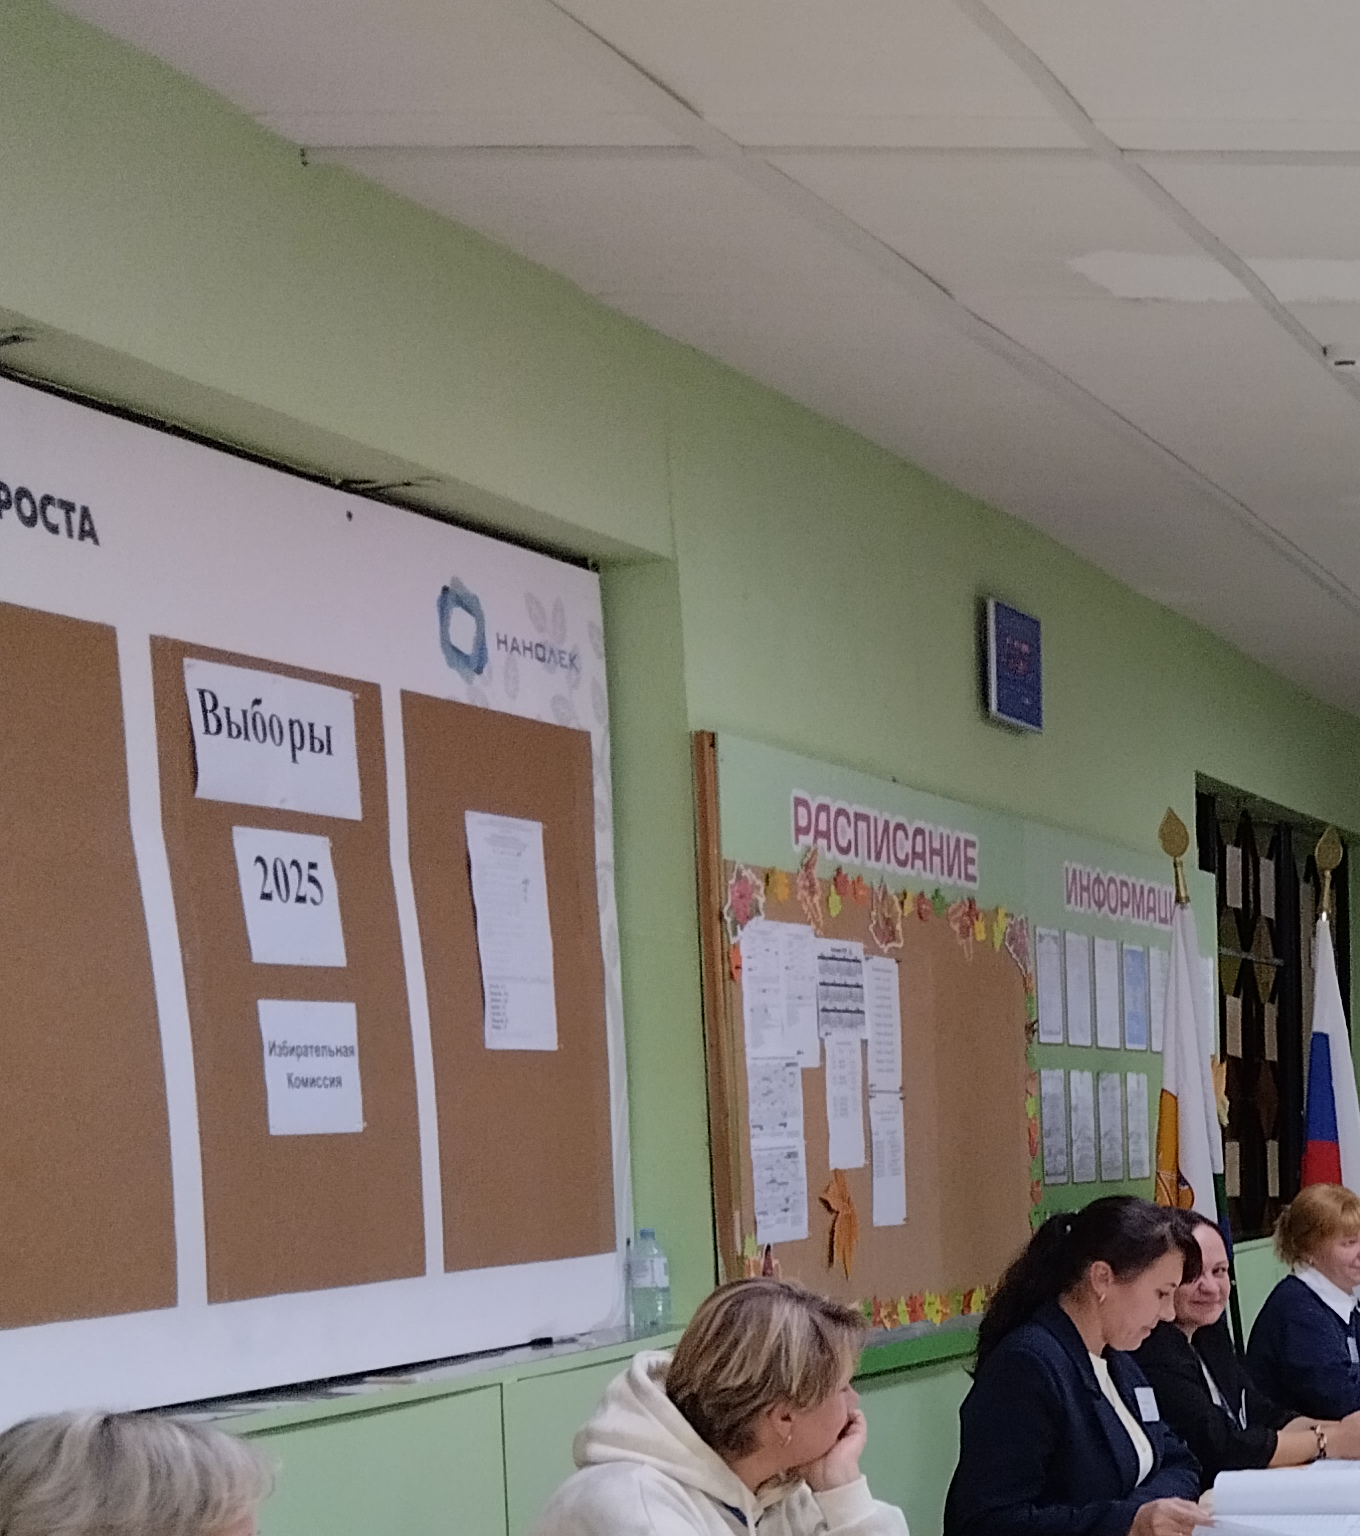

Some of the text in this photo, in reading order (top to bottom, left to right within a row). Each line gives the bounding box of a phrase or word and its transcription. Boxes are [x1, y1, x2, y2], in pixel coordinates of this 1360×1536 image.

[195, 687, 334, 765] Выборы
[793, 796, 978, 883] РАСПИСАНИЕ
[253, 855, 325, 907] 2025
[267, 1040, 356, 1062] Избирательная
[286, 1071, 343, 1090] Комиссия
